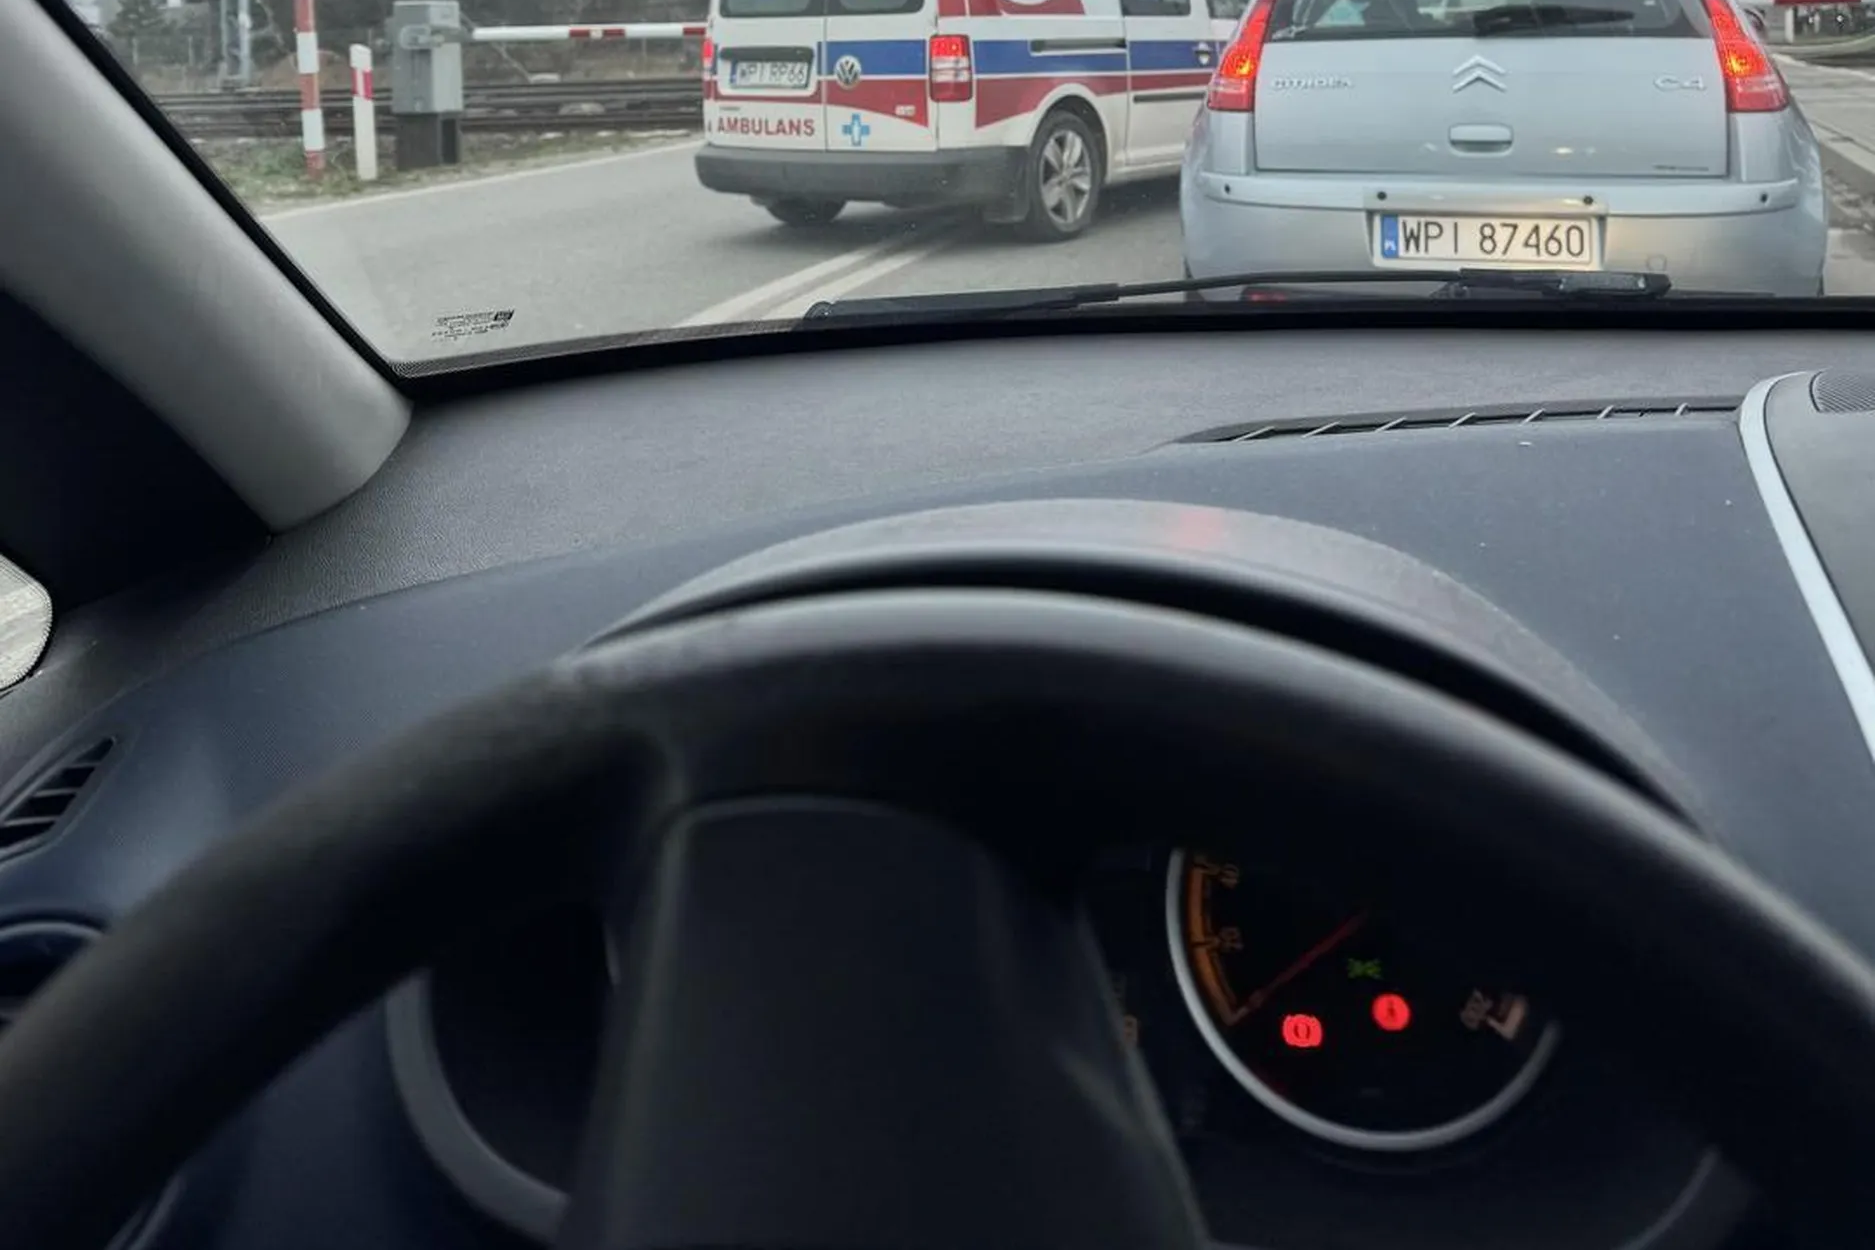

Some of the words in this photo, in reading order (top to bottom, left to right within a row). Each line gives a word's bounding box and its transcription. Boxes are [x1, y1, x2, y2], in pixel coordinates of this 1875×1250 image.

[1653, 75, 1705, 91] C4
[718, 117, 815, 136] AMBULANS
[1402, 219, 1459, 254] WPI
[1479, 222, 1585, 257] 87460
